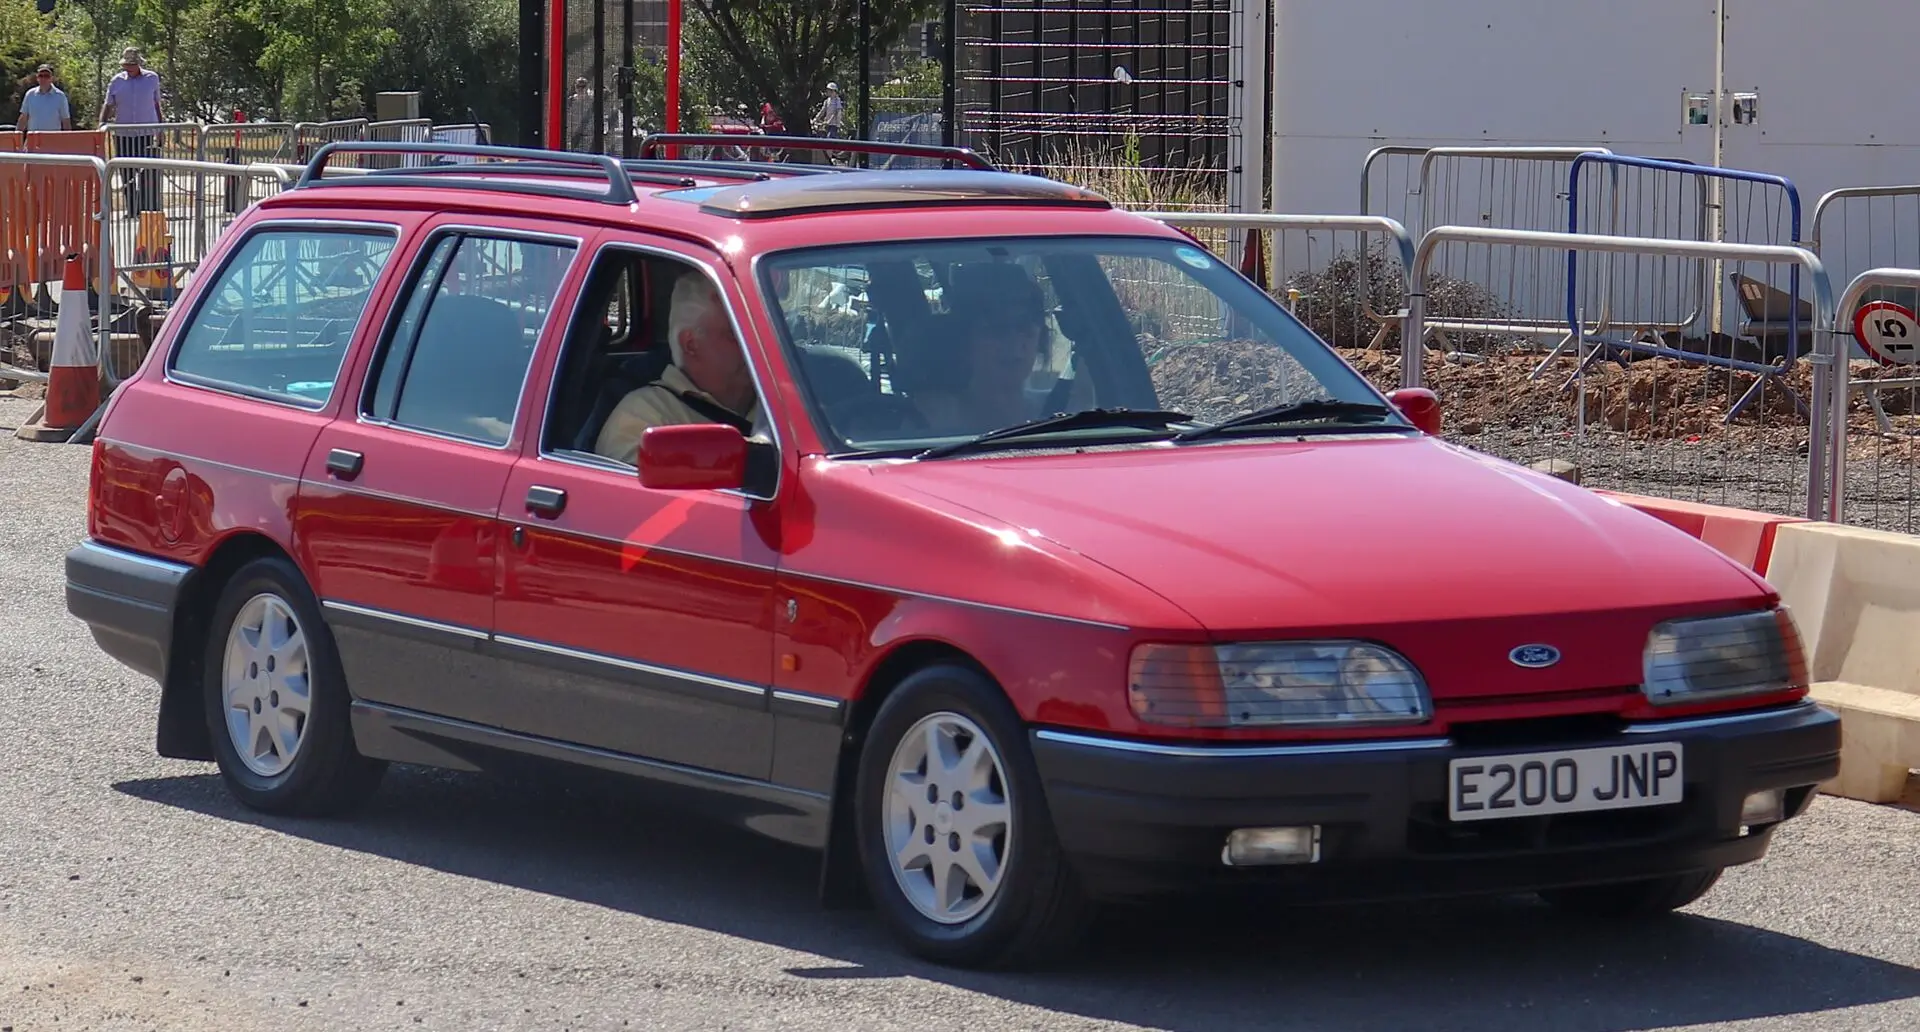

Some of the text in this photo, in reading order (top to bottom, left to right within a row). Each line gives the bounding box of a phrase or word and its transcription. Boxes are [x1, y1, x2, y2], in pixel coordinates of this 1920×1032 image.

[1874, 318, 1914, 354] 15
[1522, 648, 1549, 662] Ford
[1456, 750, 1677, 812] E200 JNP
